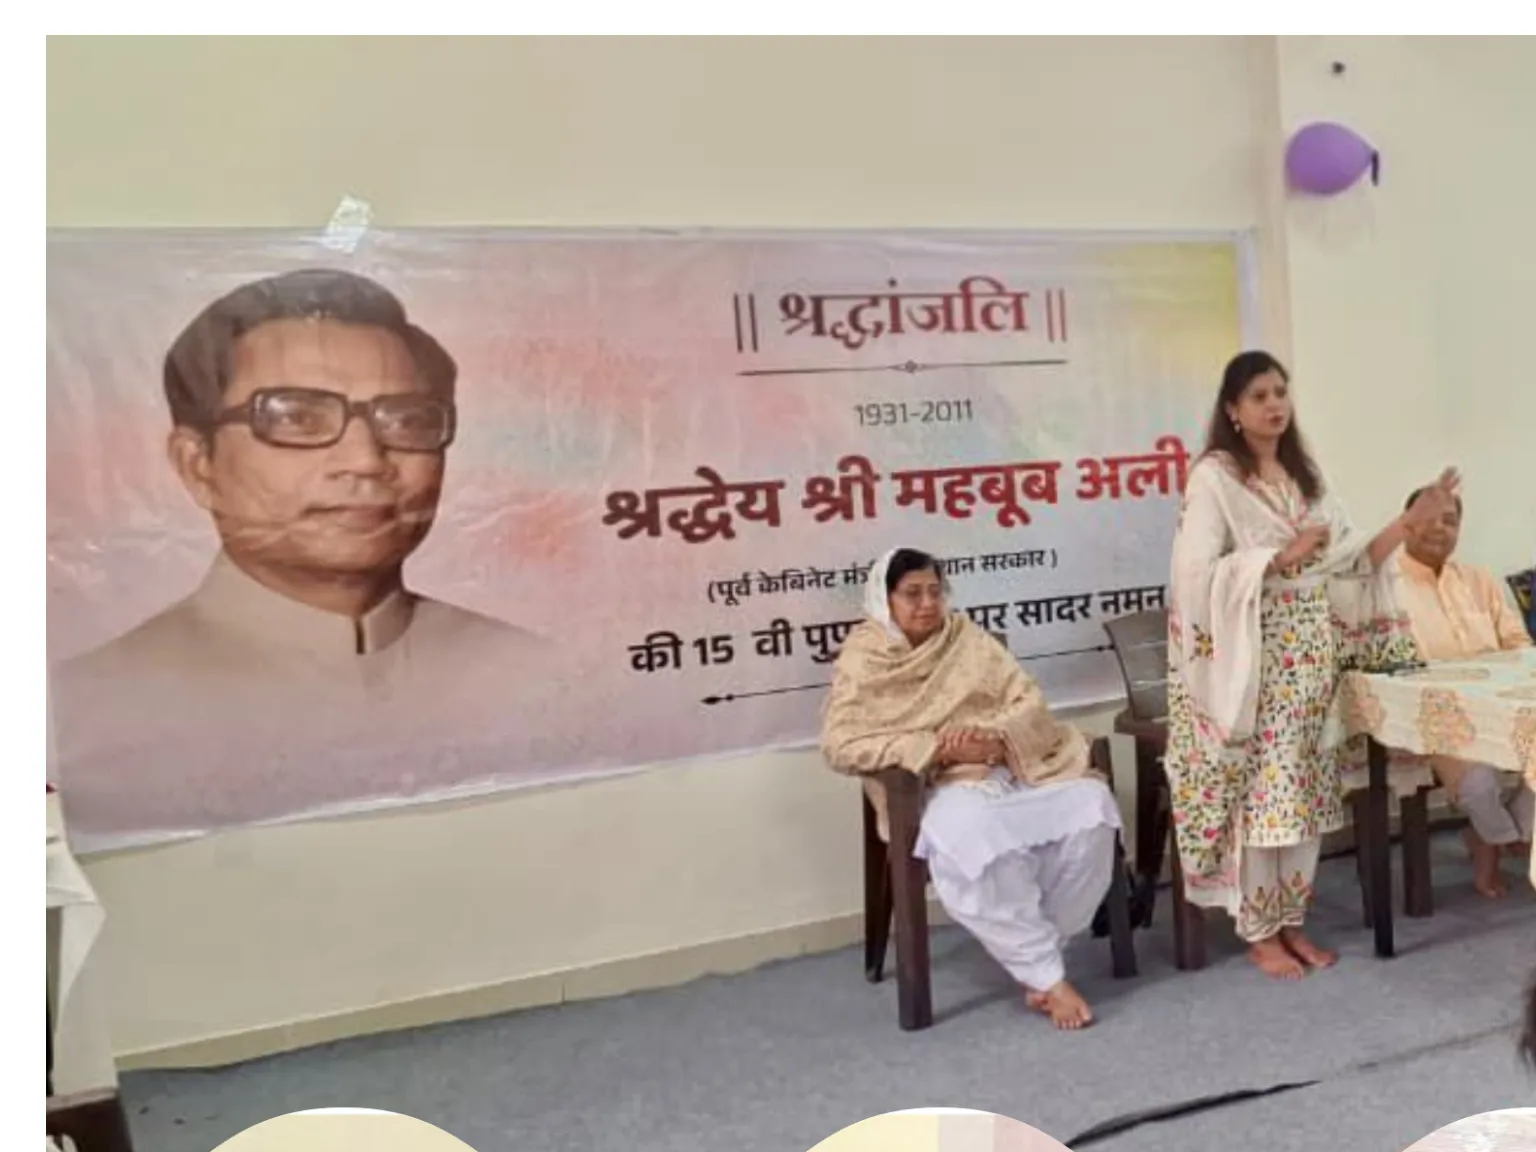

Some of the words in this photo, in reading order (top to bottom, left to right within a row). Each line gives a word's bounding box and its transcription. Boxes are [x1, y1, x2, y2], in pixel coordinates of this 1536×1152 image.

[778, 275, 1030, 350] श्रद्धांजलि
[853, 398, 973, 427] 1931-2011
[601, 465, 786, 544] श्रद्धेय
[801, 454, 881, 523] श्री
[891, 461, 1062, 528] महबूब
[1075, 435, 1190, 498] अली
[627, 631, 683, 672] की
[692, 635, 734, 665] 15
[751, 618, 795, 657] वी
[1014, 592, 1094, 626] सादर
[1098, 585, 1166, 615] नमन
